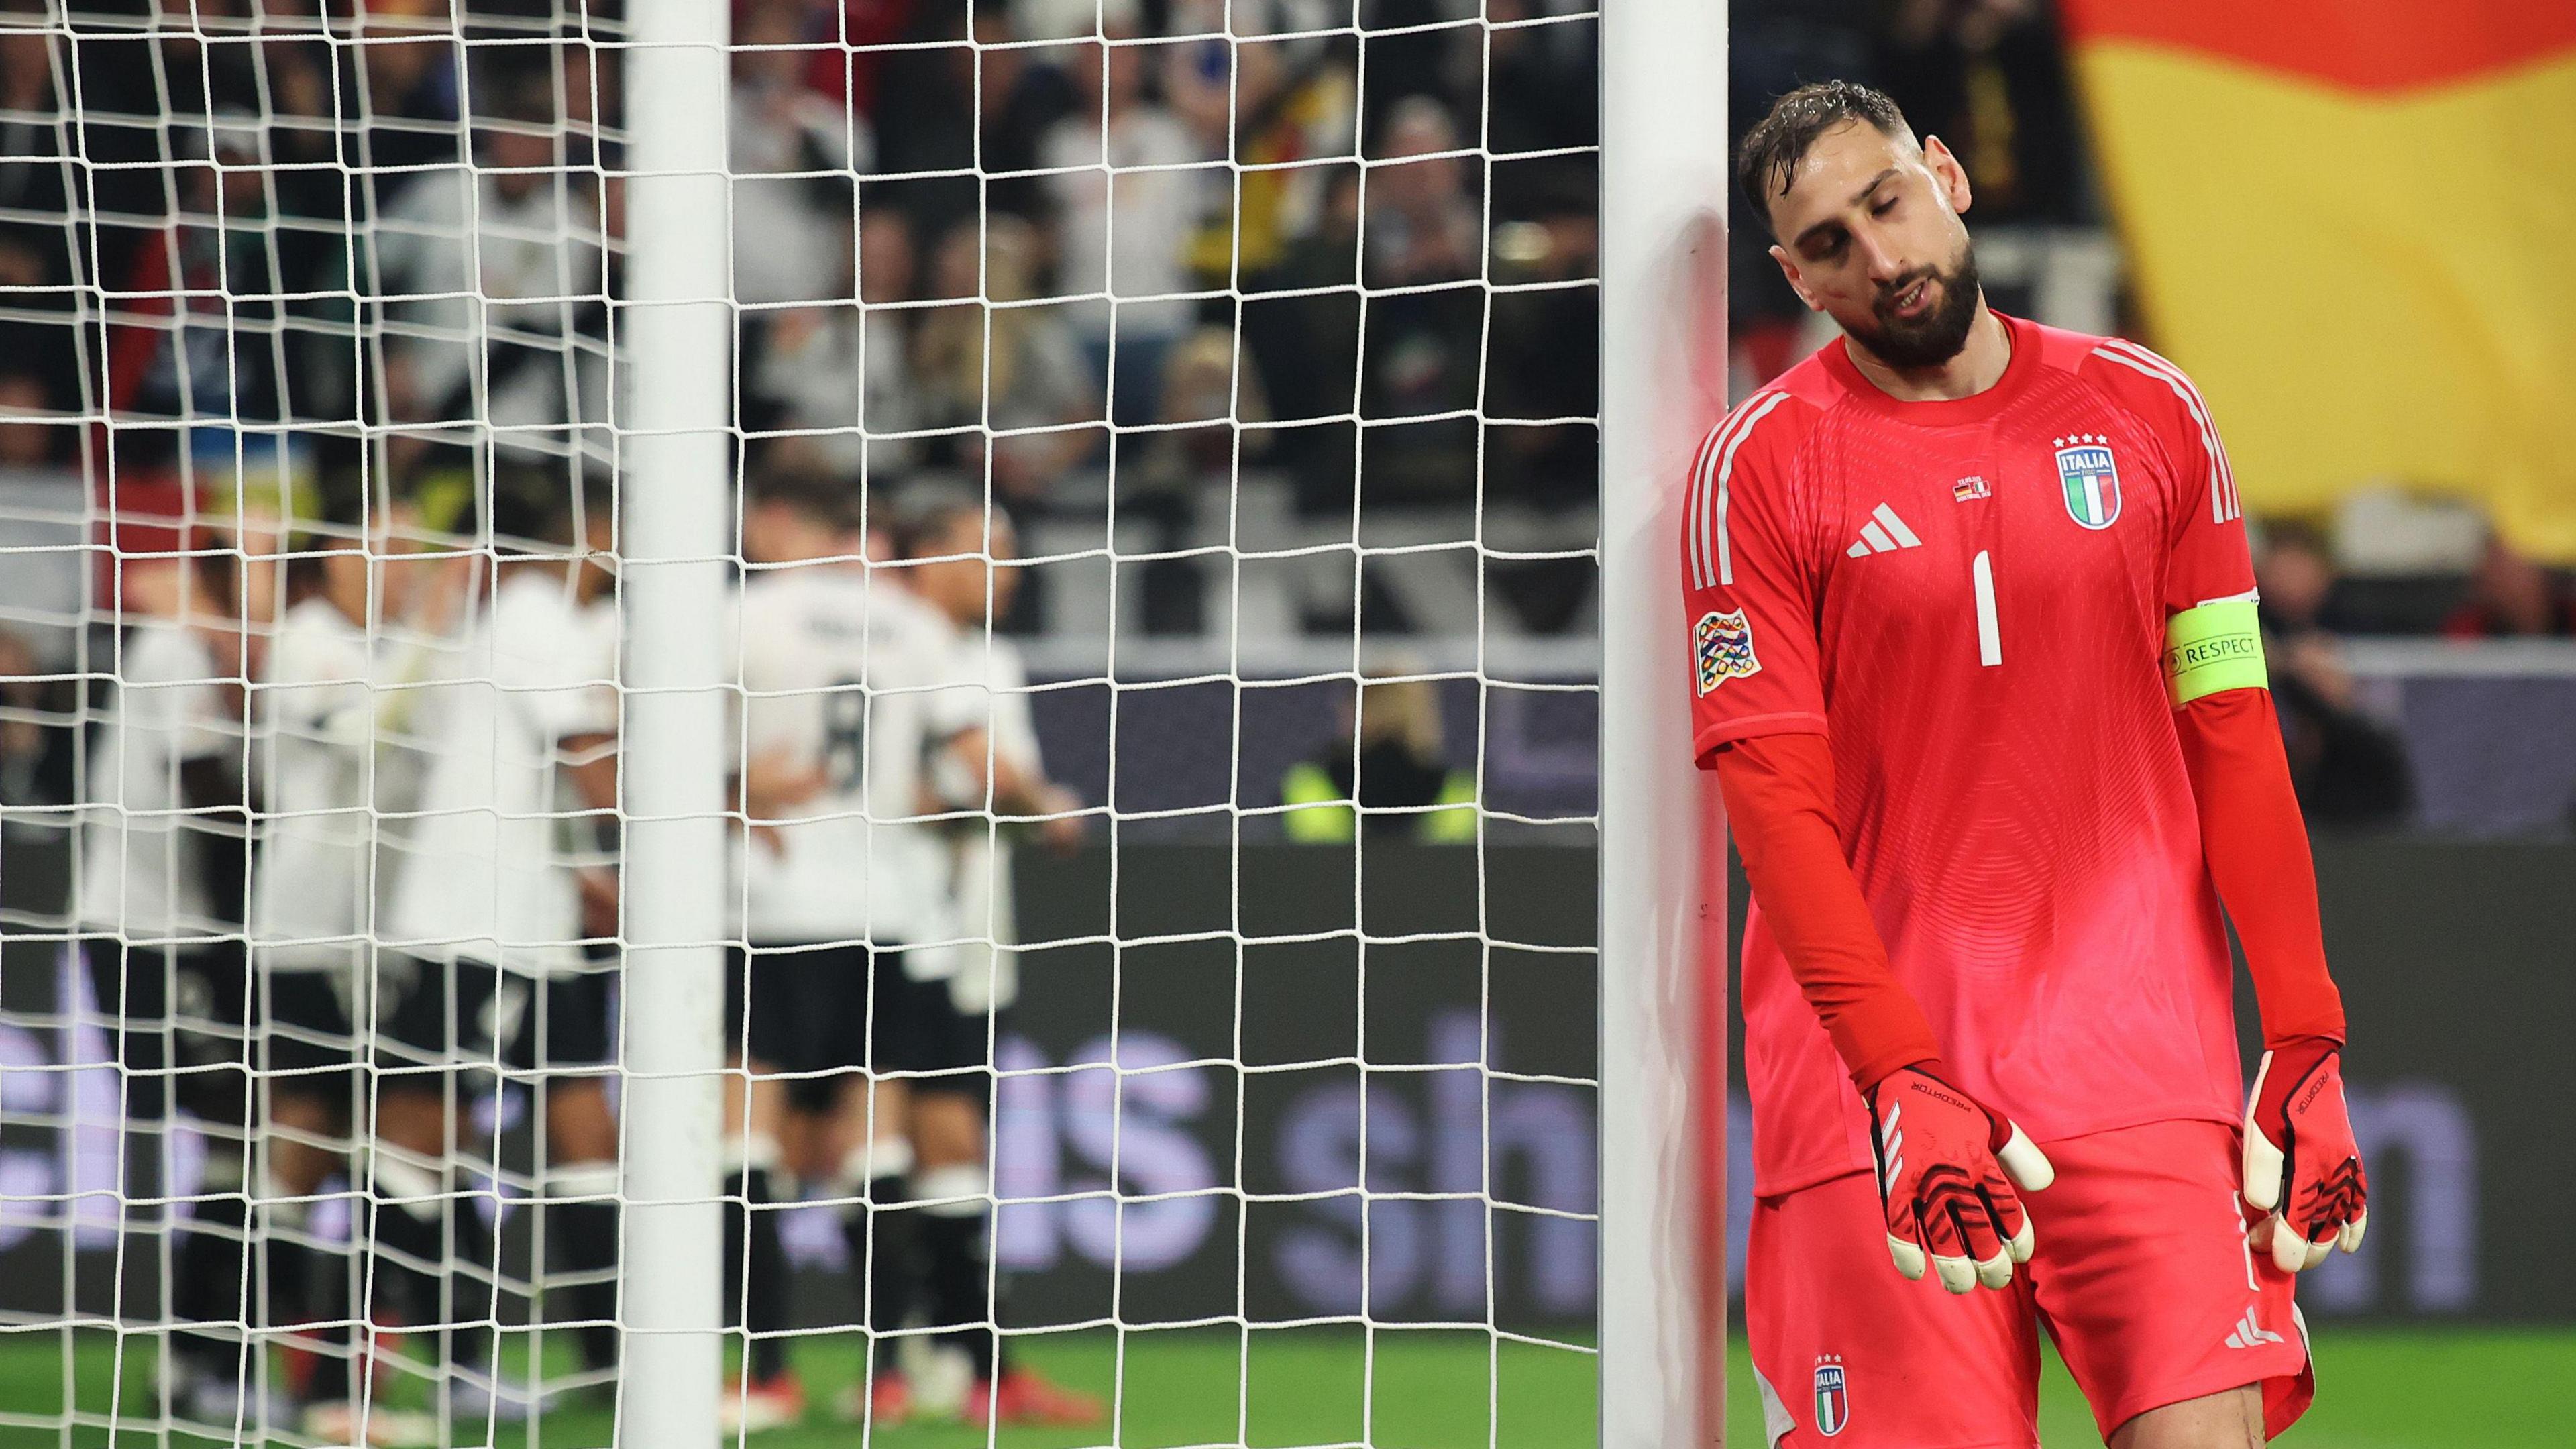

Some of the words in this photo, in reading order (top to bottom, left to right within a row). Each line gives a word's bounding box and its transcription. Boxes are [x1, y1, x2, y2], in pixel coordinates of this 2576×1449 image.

[2061, 452, 2110, 472] ITALIA
[1972, 549, 2002, 667] 1
[2186, 637, 2255, 664] RESPECT
[1911, 1081, 1972, 1113] PREDATOR
[2296, 1070, 2329, 1116] PREDATOR
